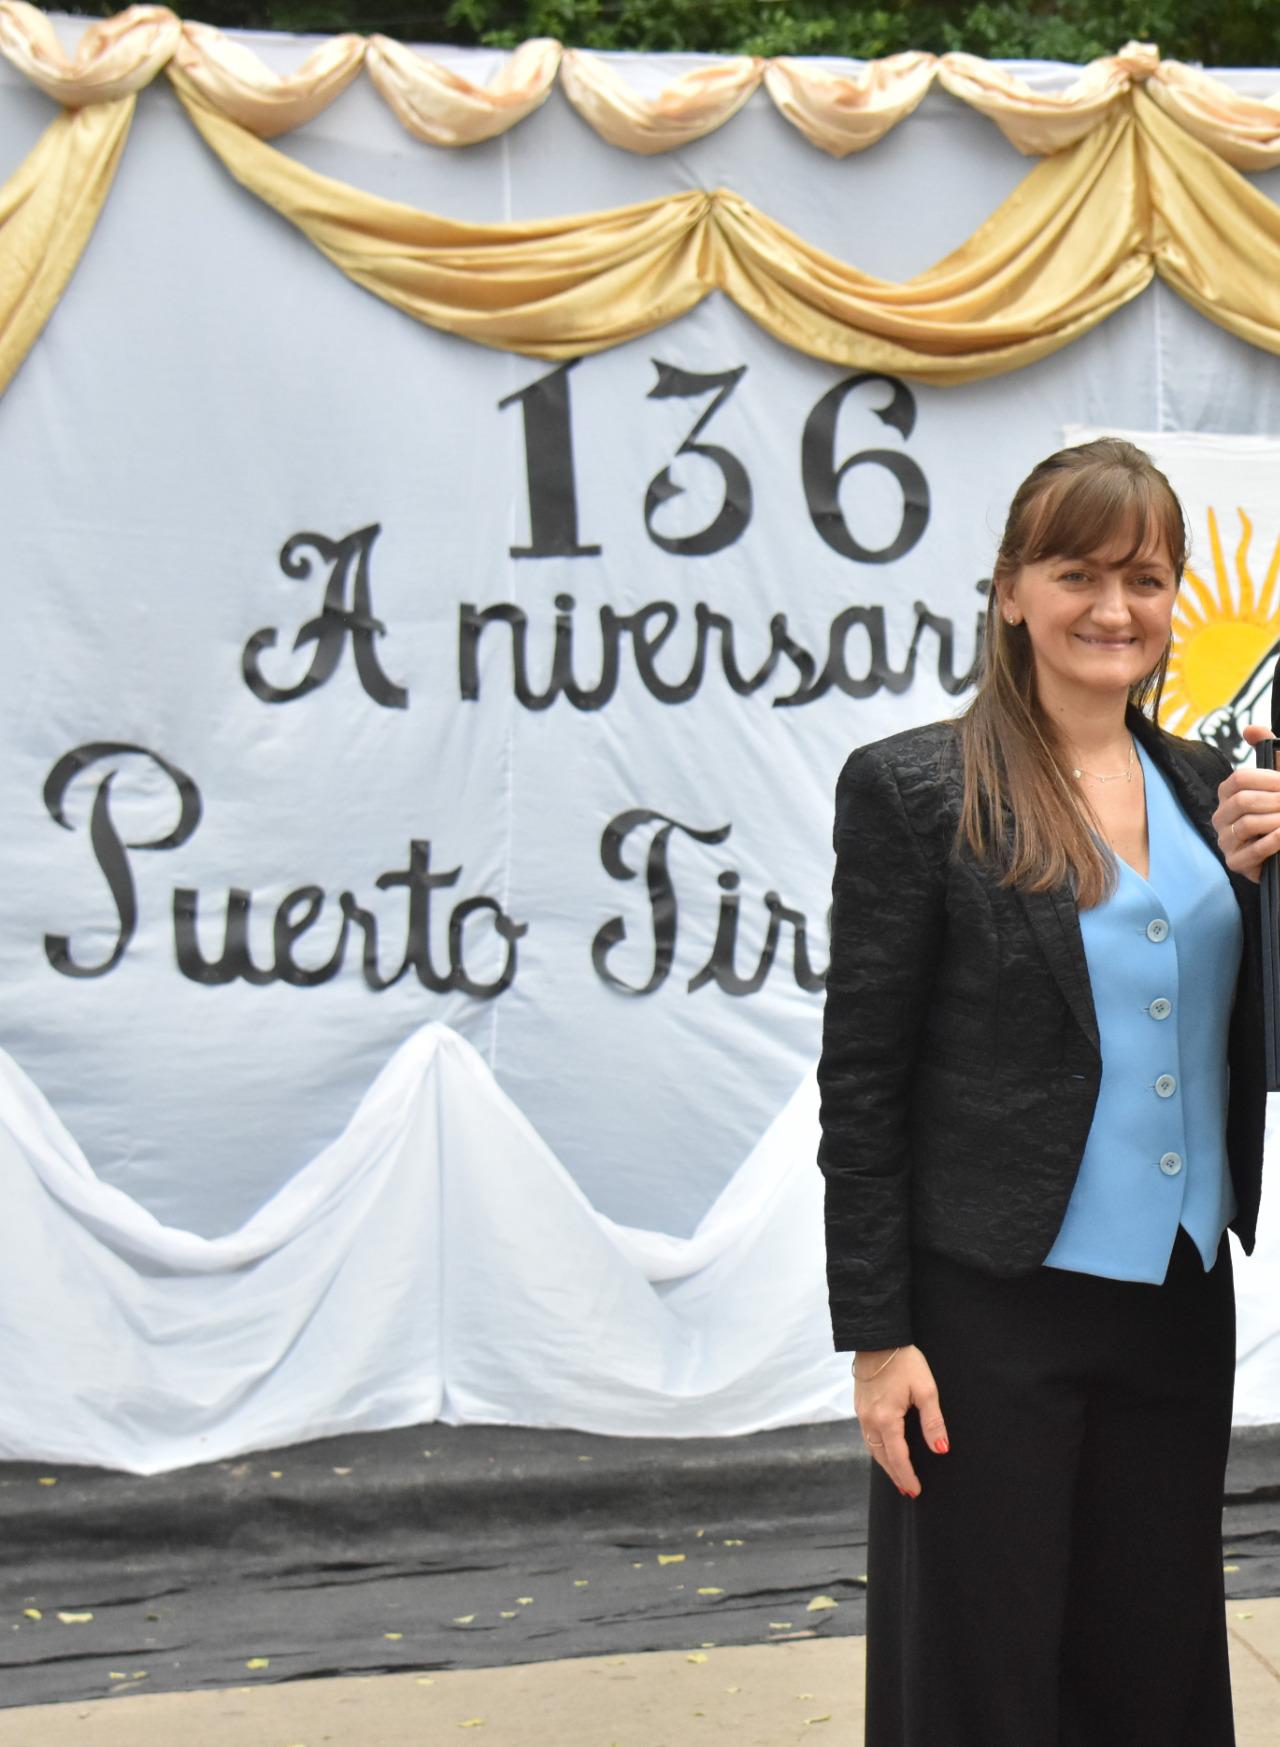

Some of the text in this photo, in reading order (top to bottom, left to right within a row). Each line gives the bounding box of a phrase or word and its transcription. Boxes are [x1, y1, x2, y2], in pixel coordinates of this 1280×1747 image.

[499, 357, 931, 564] 136
[240, 523, 988, 712] Aniversari
[42, 741, 828, 999] Puerto Tir
